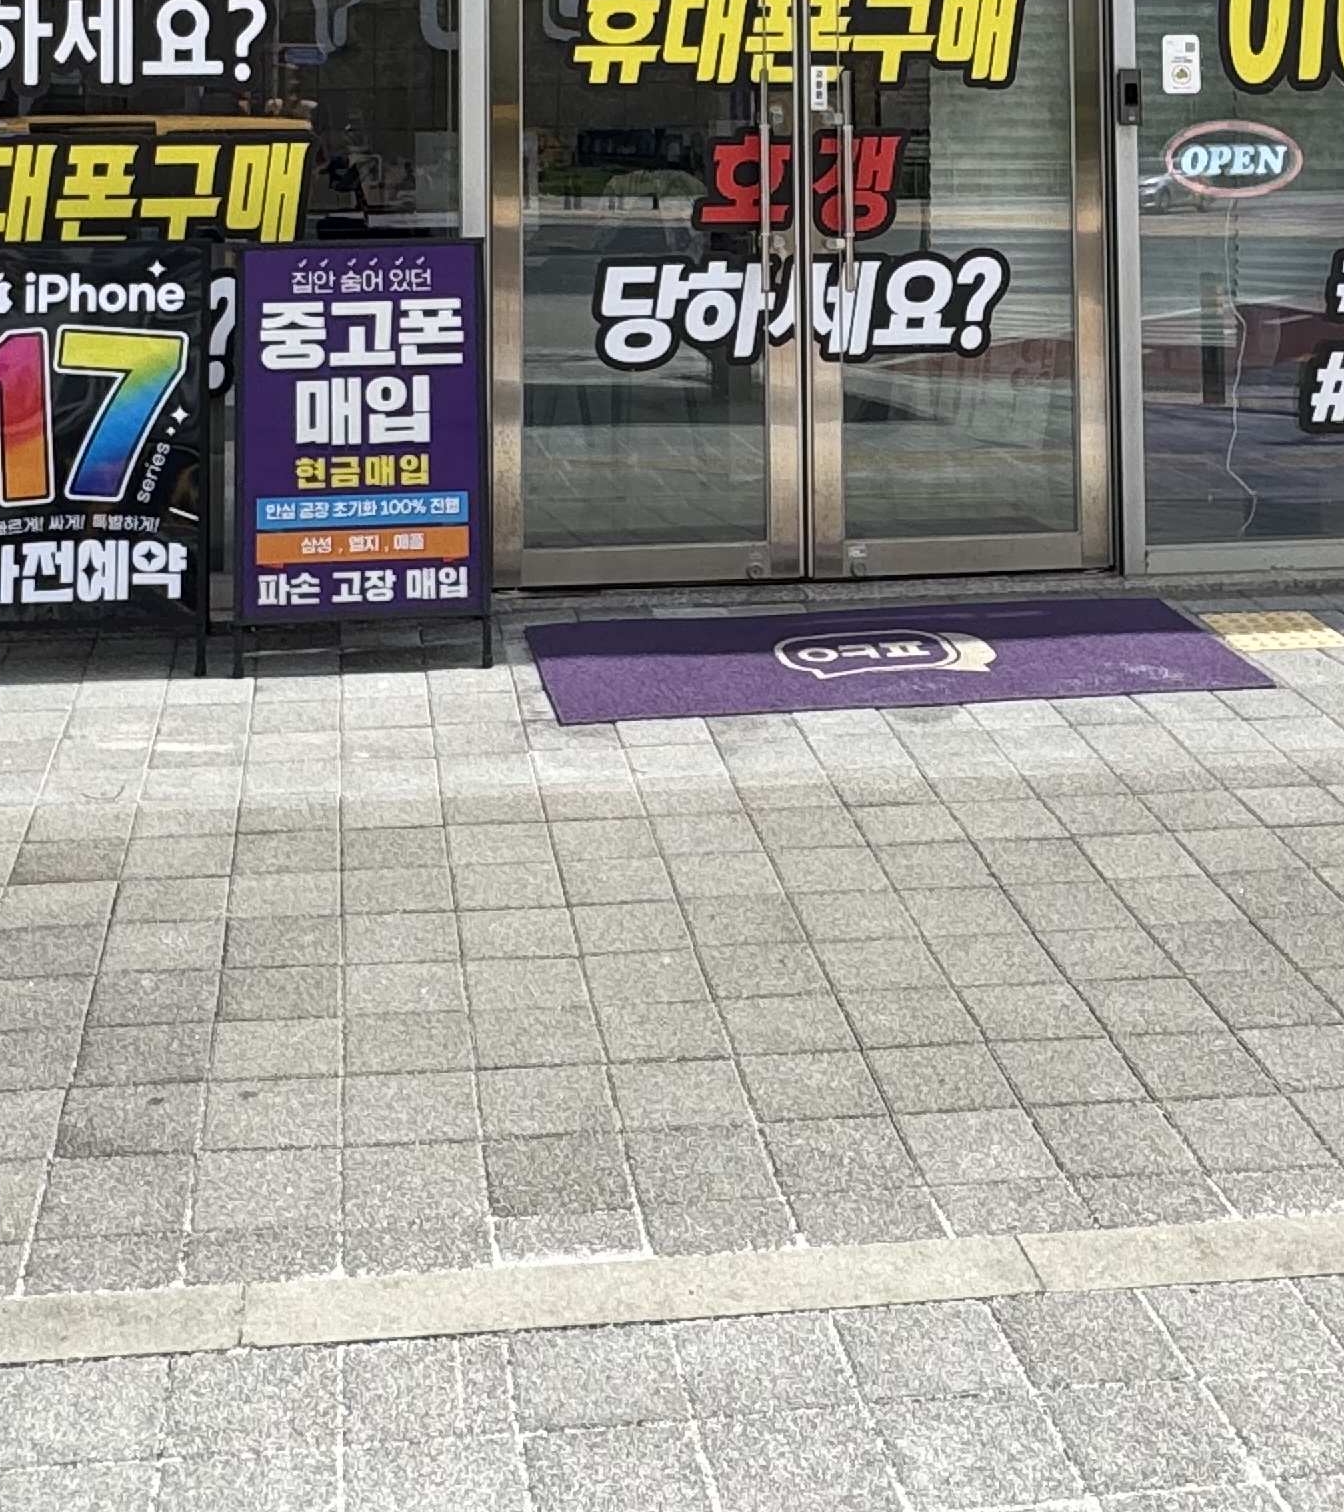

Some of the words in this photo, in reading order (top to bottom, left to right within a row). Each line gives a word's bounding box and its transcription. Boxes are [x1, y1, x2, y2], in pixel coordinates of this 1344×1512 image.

[1181, 144, 1287, 176] OPEN
[701, 134, 902, 232] 호갱
[25, 273, 186, 314] iPhone
[291, 270, 336, 294] 집안
[340, 269, 384, 294] 숨어
[389, 268, 432, 292] 있던
[601, 256, 1003, 364] 당하세요?
[260, 298, 465, 371] 중고폰
[295, 375, 431, 446] 매입
[137, 442, 171, 503] series
[295, 454, 430, 490] 현금매입
[265, 502, 296, 521] 안심
[299, 501, 330, 519] 공장
[333, 500, 377, 518] 초기화
[381, 498, 427, 515] 100%
[301, 536, 332, 554] 삼성
[257, 572, 321, 606] 파손
[331, 569, 397, 603] 고장
[406, 567, 469, 600] 매입
